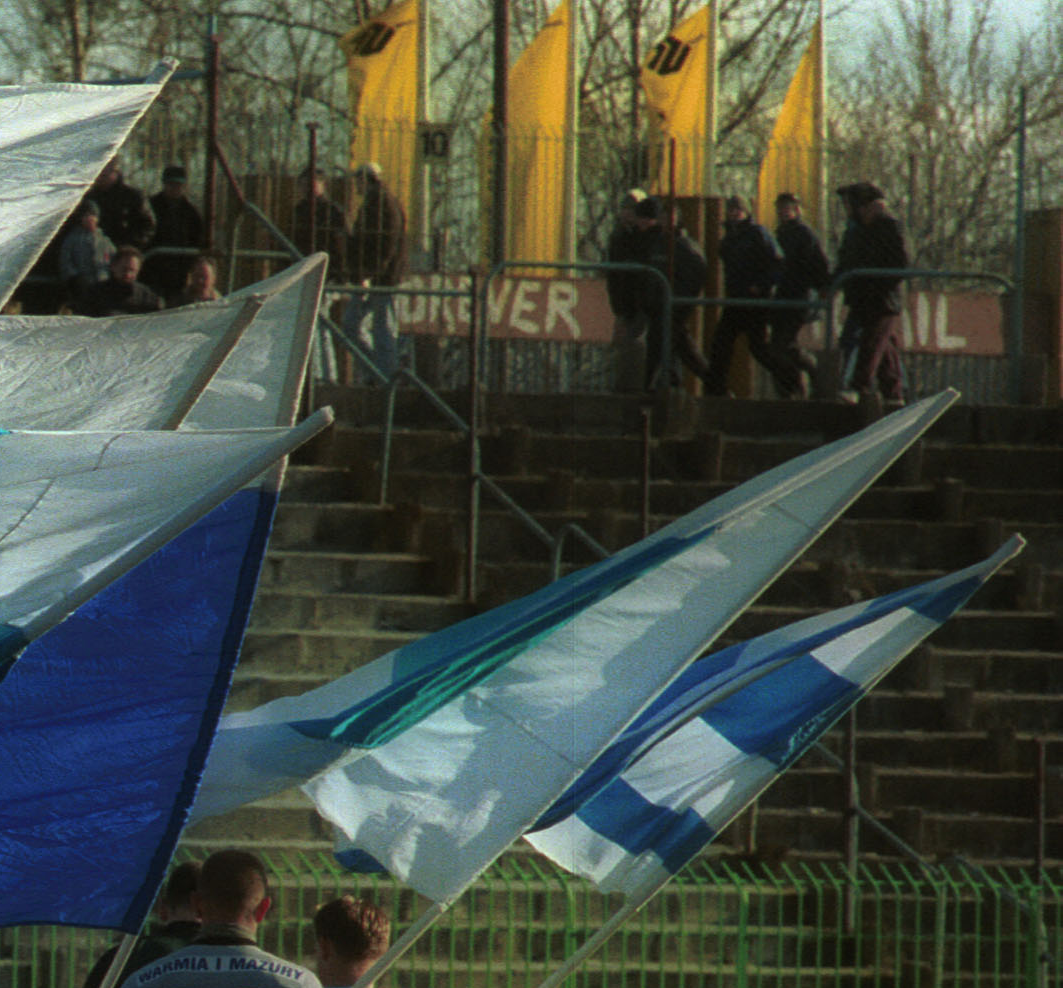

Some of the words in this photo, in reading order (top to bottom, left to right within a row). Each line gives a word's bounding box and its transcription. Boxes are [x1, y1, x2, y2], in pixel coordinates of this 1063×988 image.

[139, 958, 209, 984] WARMIA
[215, 957, 222, 971] I
[229, 957, 305, 980] MAZURY
